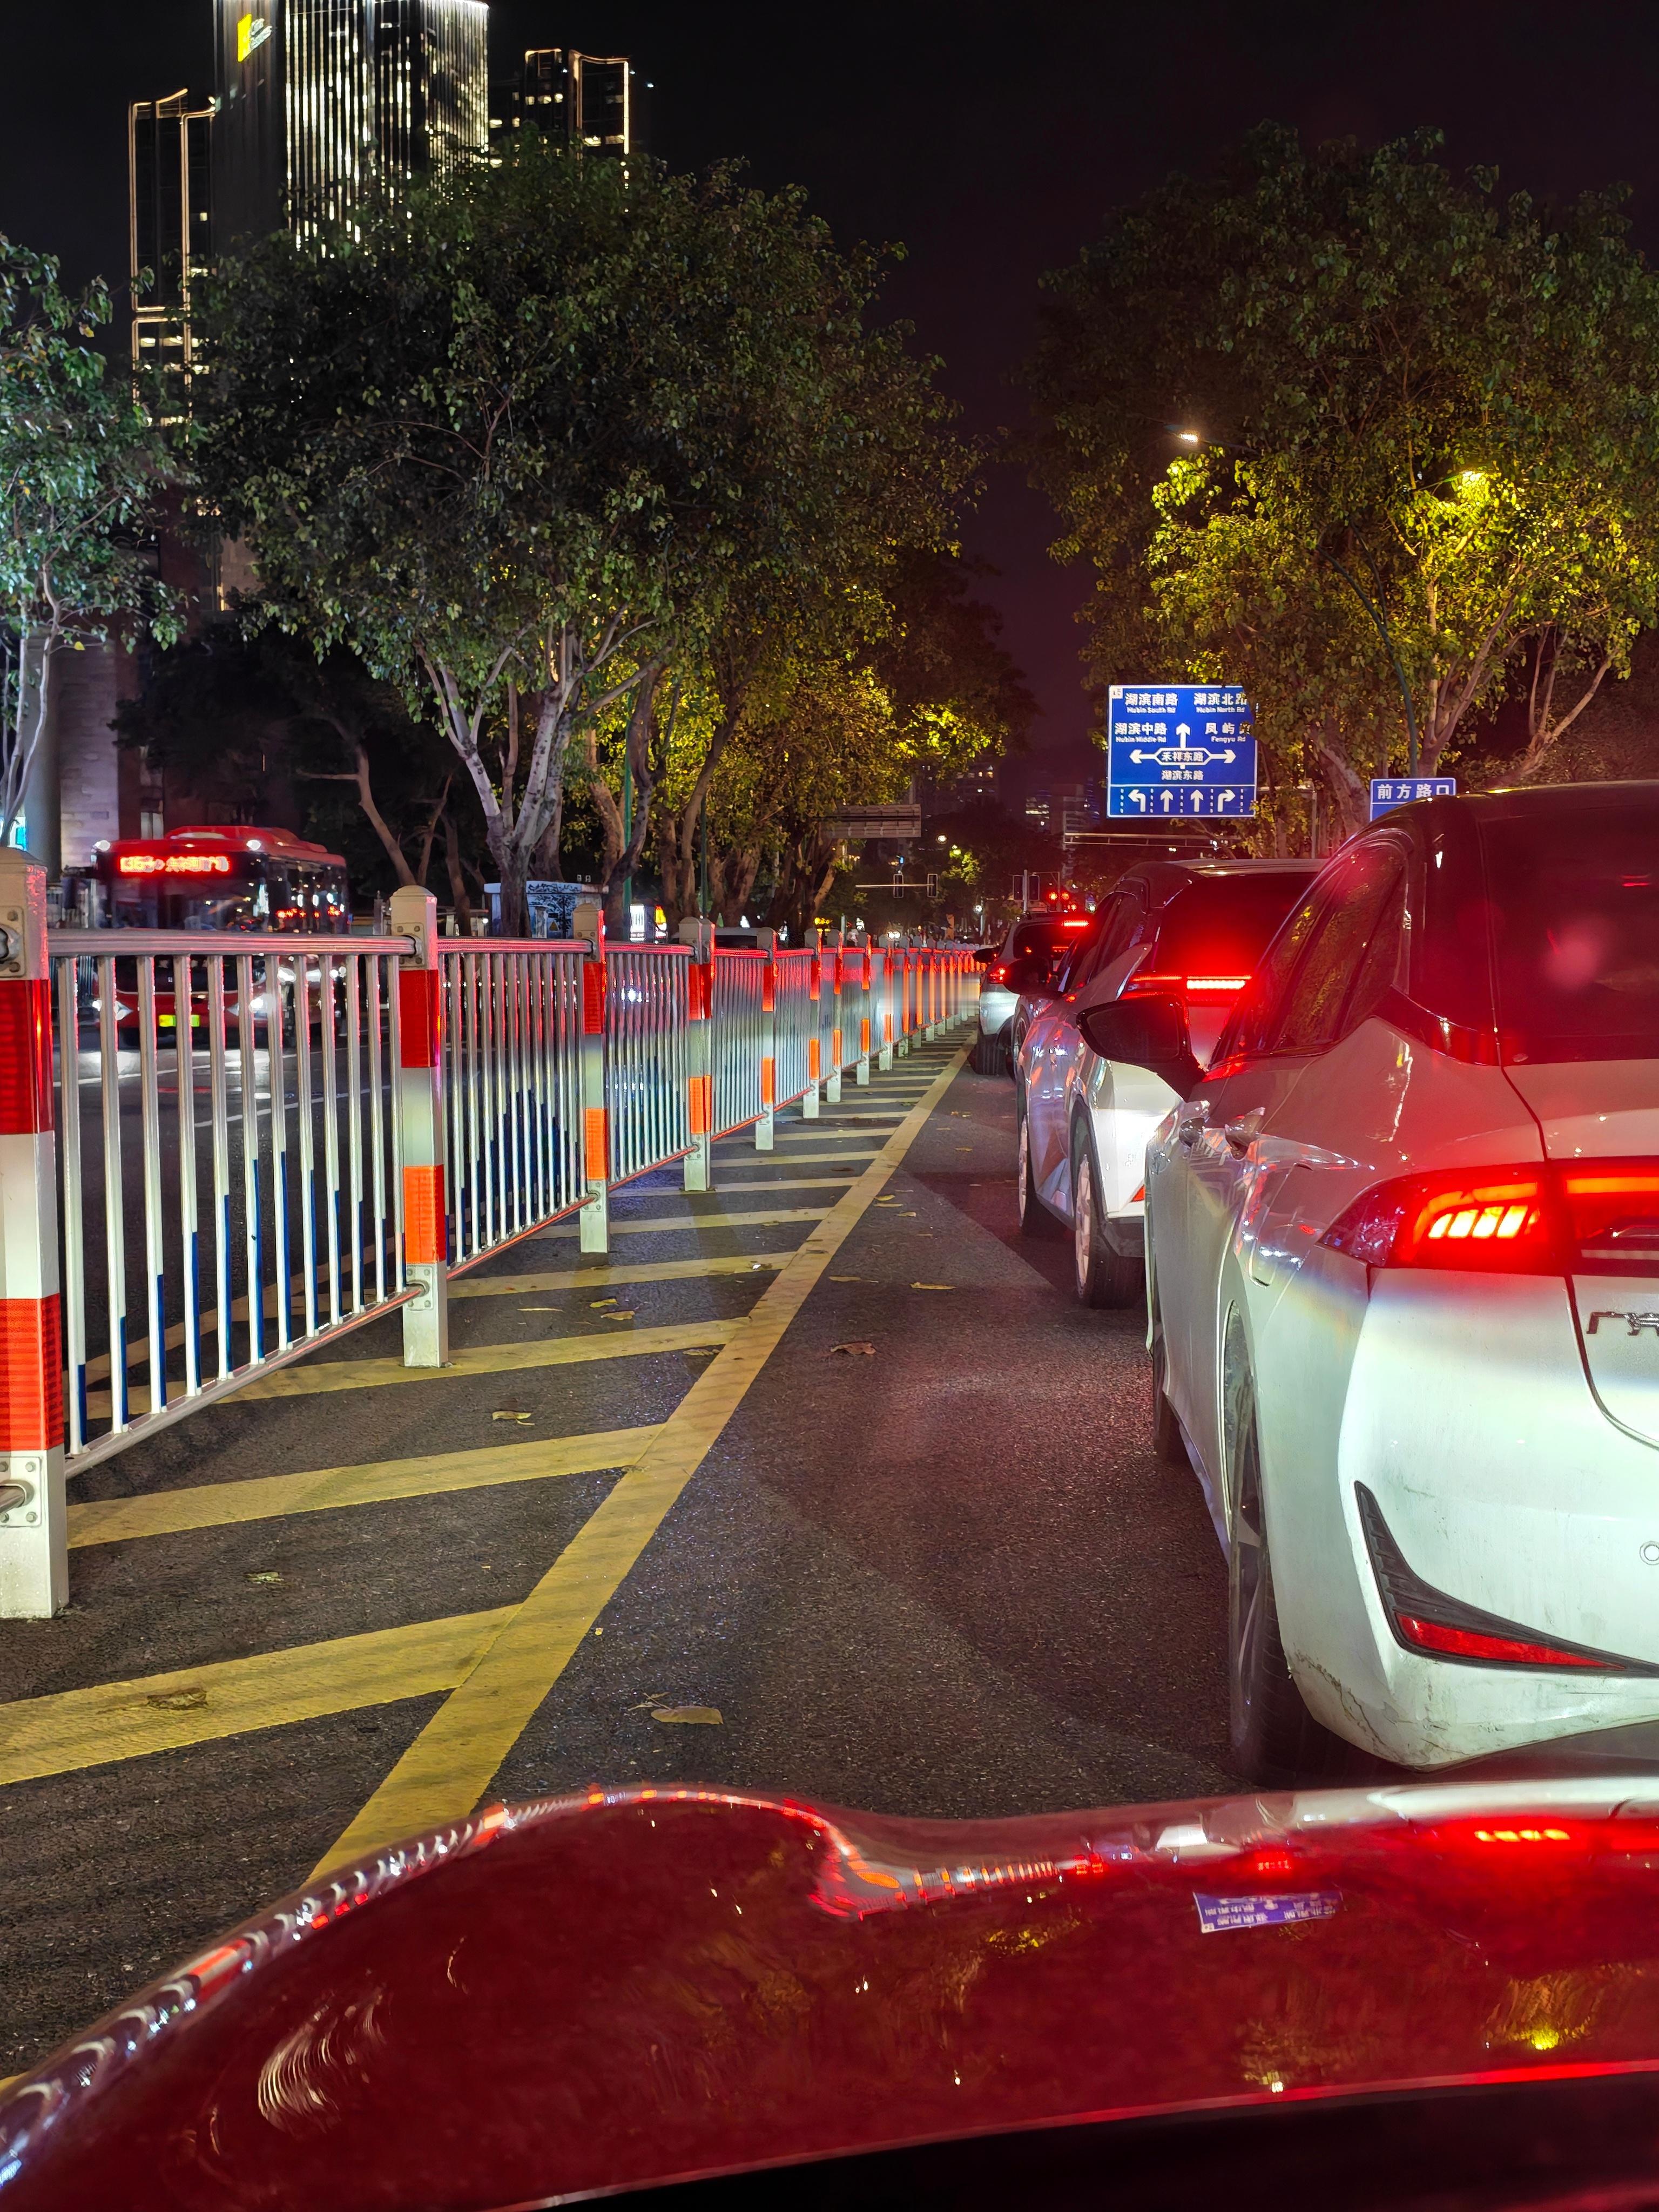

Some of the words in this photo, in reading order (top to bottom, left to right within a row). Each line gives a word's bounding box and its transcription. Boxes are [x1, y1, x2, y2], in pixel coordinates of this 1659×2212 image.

[1125, 692, 1178, 706] 湖滨南路
[1193, 692, 1247, 705] 湖滨北路
[1114, 722, 1168, 735] 湖滨中路
[1162, 751, 1204, 762] 禾祥东路
[1162, 770, 1204, 780] 湖滨东路
[1377, 784, 1449, 799] 前方路口
